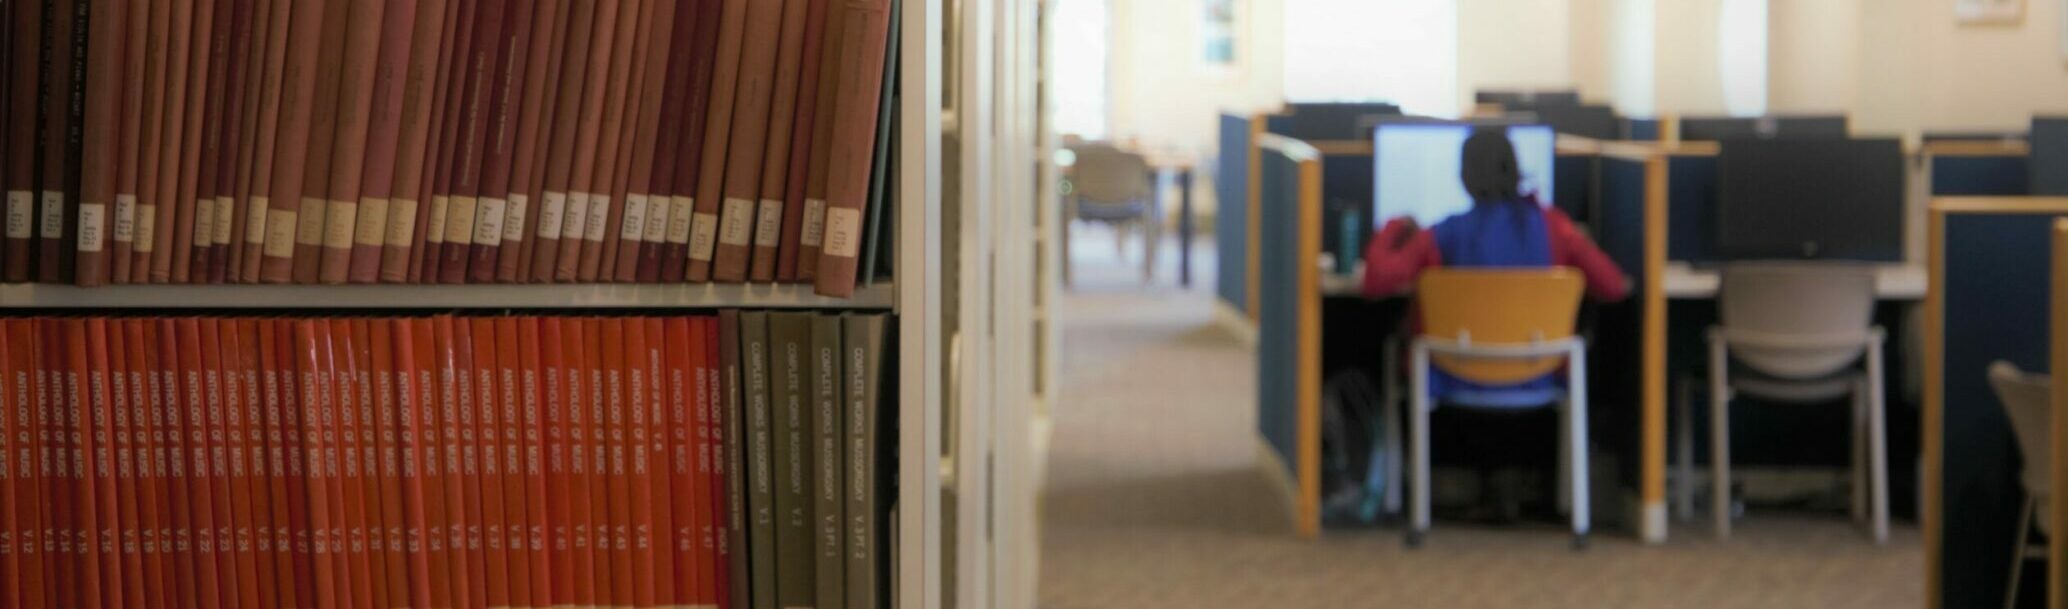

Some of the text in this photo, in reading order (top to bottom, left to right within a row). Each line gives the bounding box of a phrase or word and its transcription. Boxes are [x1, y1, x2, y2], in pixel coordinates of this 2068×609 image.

[787, 342, 798, 390] COMPLETE
[822, 348, 832, 396] COMPLETE
[854, 348, 864, 396] COMPLETE
[93, 371, 104, 425] ANTHOLOGY
[149, 372, 162, 426] ANTHOLOGY
[360, 370, 372, 424] ANTHOLOGY
[459, 369, 471, 424] ANTHOLOGY
[504, 368, 515, 423] ANTHOLOGY
[673, 368, 684, 422] ANTHOLOGY
[710, 369, 721, 423] ANTHOLOGY
[789, 395, 800, 428] WORKS
[823, 400, 832, 434] WORKS
[854, 400, 864, 434] WORKS
[96, 430, 106, 442] OF
[154, 431, 163, 443] OF
[165, 371, 187, 550] ANTHOLOGY OF MUSIC V.21
[207, 370, 230, 551] ANTHOLOGY OF MUSIC V.23
[248, 370, 268, 550] ANTHOLOGY OF MUSIC V.25
[364, 430, 373, 441] OF
[365, 446, 376, 475] MUSIC
[421, 370, 441, 550] ANTHOLOGY OF MUSIC V.34
[463, 429, 472, 441] OF
[464, 446, 474, 474] MUSIC
[481, 369, 499, 548] ANTHOLOGY OF MUSIC V.37
[506, 428, 516, 440] OF
[507, 445, 518, 473] MUSIC
[525, 370, 541, 549] ANTHOLOGY OF MUSIC V.39
[569, 368, 586, 546] ANTHOLOGY OF MUSIC V.41
[592, 369, 608, 548] ANTHOLOGY OF MUSIC V.42
[611, 370, 626, 549] ANTHOLOGY OF MUSIC V.43
[632, 369, 647, 547] ANTHOLOGY OF MUSIC V.44
[675, 428, 684, 439] OF
[676, 444, 686, 473] MUSIC
[713, 428, 722, 440] OF
[714, 445, 724, 474] MUSIC
[752, 342, 768, 524] COMPLETE WORKS MUSSORGSKY V.1
[18, 372, 33, 553] ANTHOLOGY OF MUSIC V.12
[52, 371, 70, 552] ANTHOLOGY OF MUSIC V.14
[69, 372, 87, 553] ANTHOLOGY OF MUSIC V.15
[97, 447, 108, 476] MUSIC
[114, 372, 135, 552] ANTHOLOGY OF MUSIC V.18
[132, 371, 154, 552] ANTHOLOGY OF MUSIC V.19
[155, 448, 166, 476] MUSIC
[189, 371, 210, 552] ANTHOLOGY OF MUSIC V.22
[227, 371, 248, 551] ANTHOLOGY OF MUSIC V.24
[267, 371, 288, 551] ANTHOLOGY OF MUSIC V.26
[304, 372, 326, 553] ANTHOLOGY OF MUSIC V.28
[320, 371, 342, 552] ANTHOLOGY OF MUSIC V.29
[340, 371, 362, 552] ANTHOLOGY OF MUSIC V.30
[380, 371, 401, 551] ANTHOLOGY OF MUSIC V.32
[399, 372, 419, 552] ANTHOLOGY OF MUSIC V.33
[790, 432, 800, 494] MUSSORGSKY
[824, 438, 834, 501] MUSSORGSKY
[854, 438, 864, 501] MUSSORGSKY
[0, 531, 10, 553] V.11
[296, 529, 308, 552] V.27
[703, 525, 713, 547] V.47
